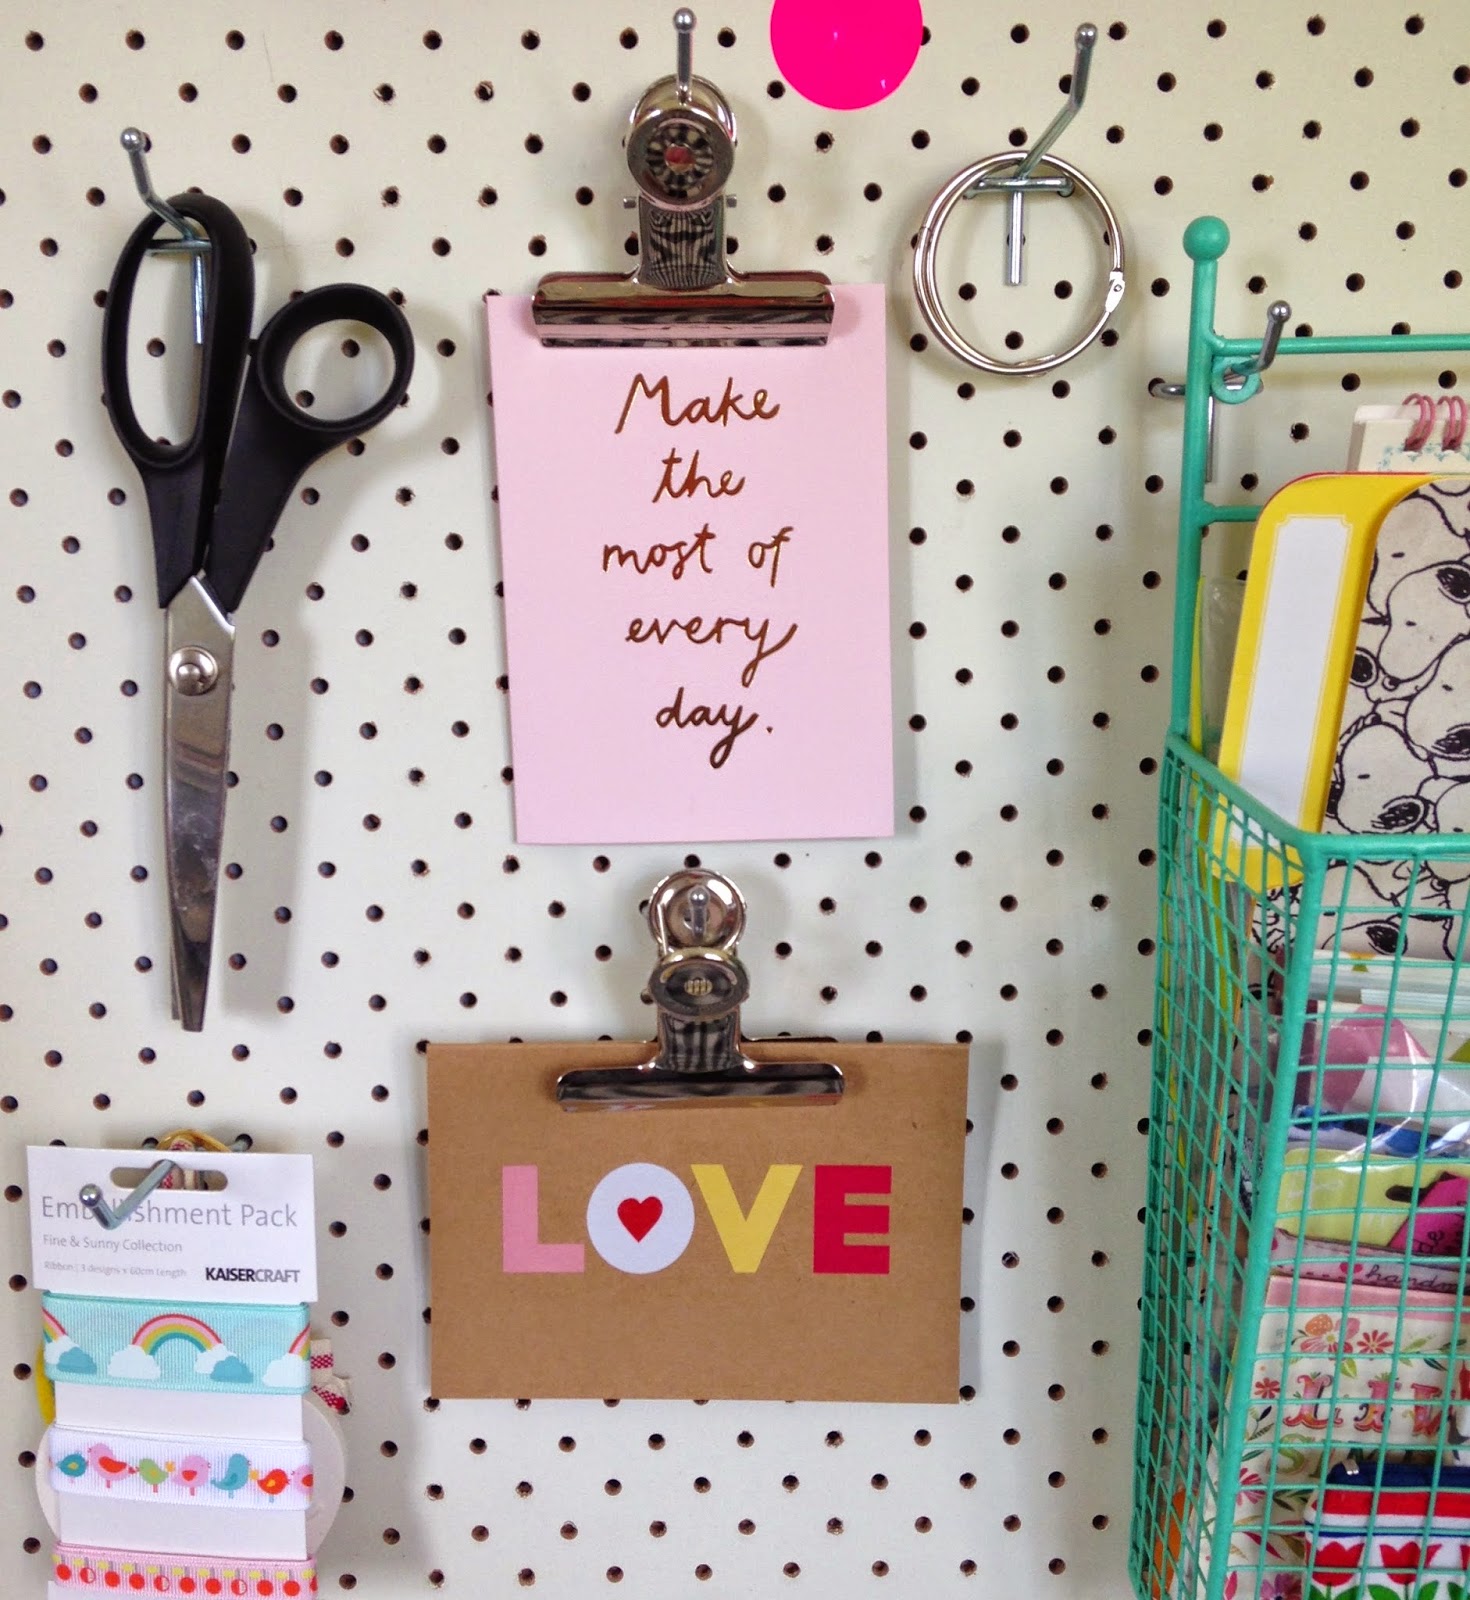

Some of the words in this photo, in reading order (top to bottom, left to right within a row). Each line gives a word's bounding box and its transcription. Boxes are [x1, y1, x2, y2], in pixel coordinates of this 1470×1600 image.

[614, 372, 780, 434] Make
[652, 447, 745, 503] the
[603, 523, 716, 580] most
[748, 526, 794, 587] of
[625, 616, 798, 688] every
[656, 686, 773, 769] day.
[43, 1234, 67, 1248] Fine
[70, 1236, 81, 1248] &
[83, 1237, 120, 1253] Sunny
[122, 1239, 183, 1253] Collection
[241, 1203, 298, 1228] Pack
[502, 1162, 892, 1275] LOVE
[205, 1267, 300, 1283] KAISERCRAFT
